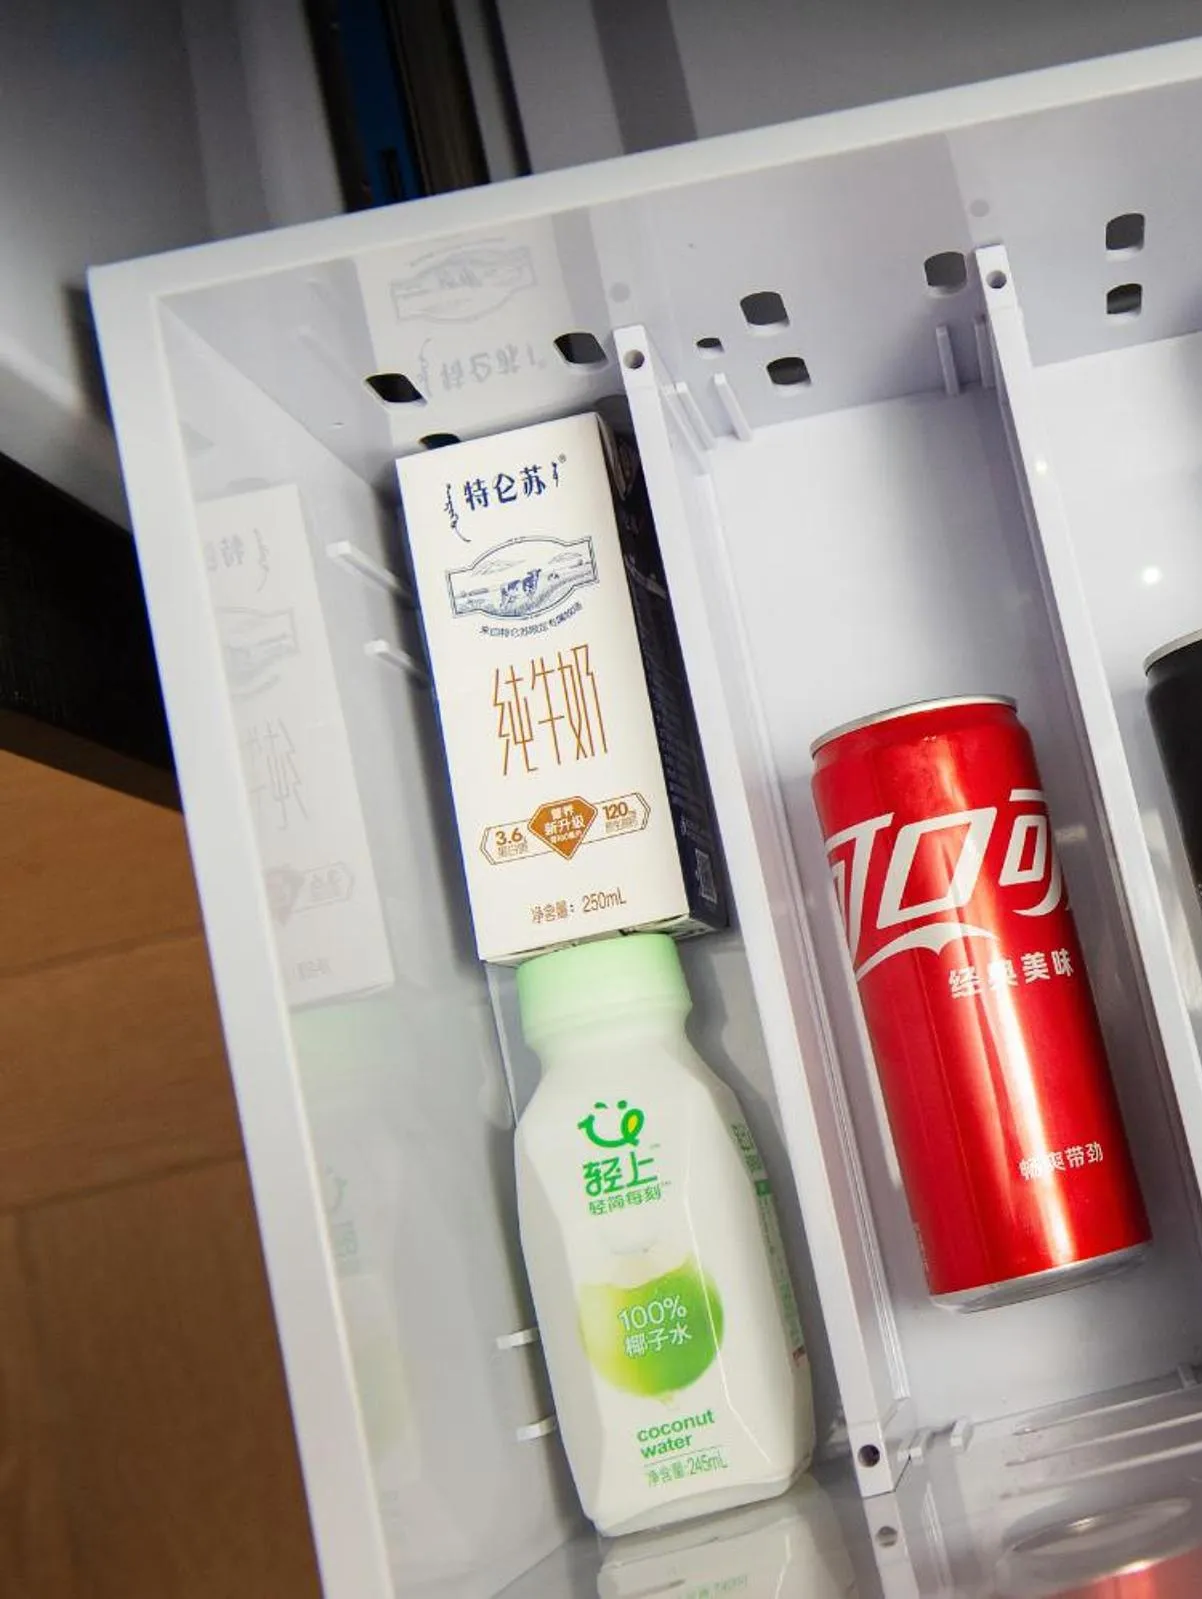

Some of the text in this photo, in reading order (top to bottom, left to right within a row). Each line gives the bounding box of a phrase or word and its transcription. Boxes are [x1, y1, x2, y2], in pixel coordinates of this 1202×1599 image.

[463, 464, 548, 512] 特仑苏
[492, 643, 608, 776] 纯牛奶
[948, 950, 1074, 999] 经典美味
[582, 1151, 658, 1198] 轻上
[617, 1294, 688, 1331] 100%
[624, 1323, 693, 1359] 椰子水
[636, 1409, 716, 1443] coconut
[640, 1433, 694, 1460] water
